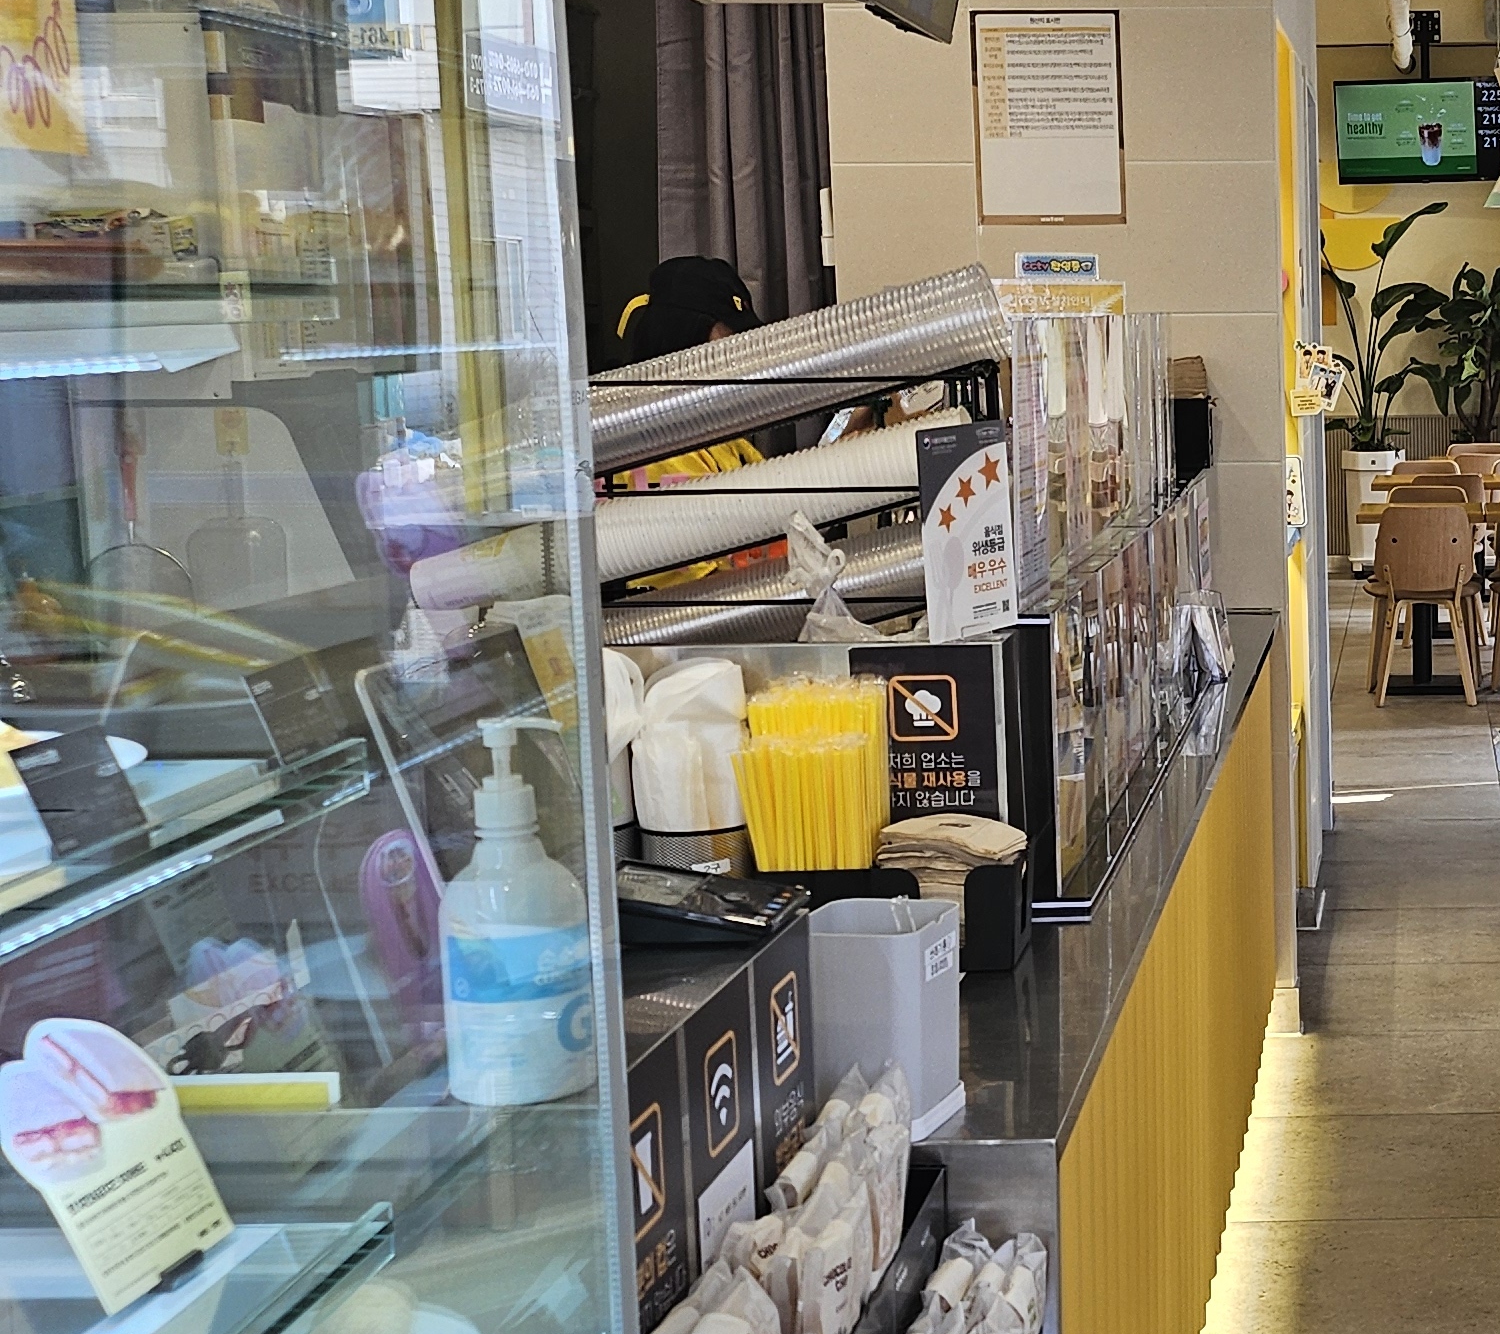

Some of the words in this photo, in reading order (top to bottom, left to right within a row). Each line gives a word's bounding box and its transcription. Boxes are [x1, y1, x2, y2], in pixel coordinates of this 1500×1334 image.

[1347, 122, 1384, 135] healthy
[971, 536, 1005, 556] 위생등급
[973, 578, 1008, 594] EXCELLENT
[889, 752, 916, 769] 저희
[920, 752, 965, 768] 업소는
[889, 771, 917, 788] 식물
[922, 770, 981, 788] 재사용을
[915, 790, 976, 808] 않습니다
